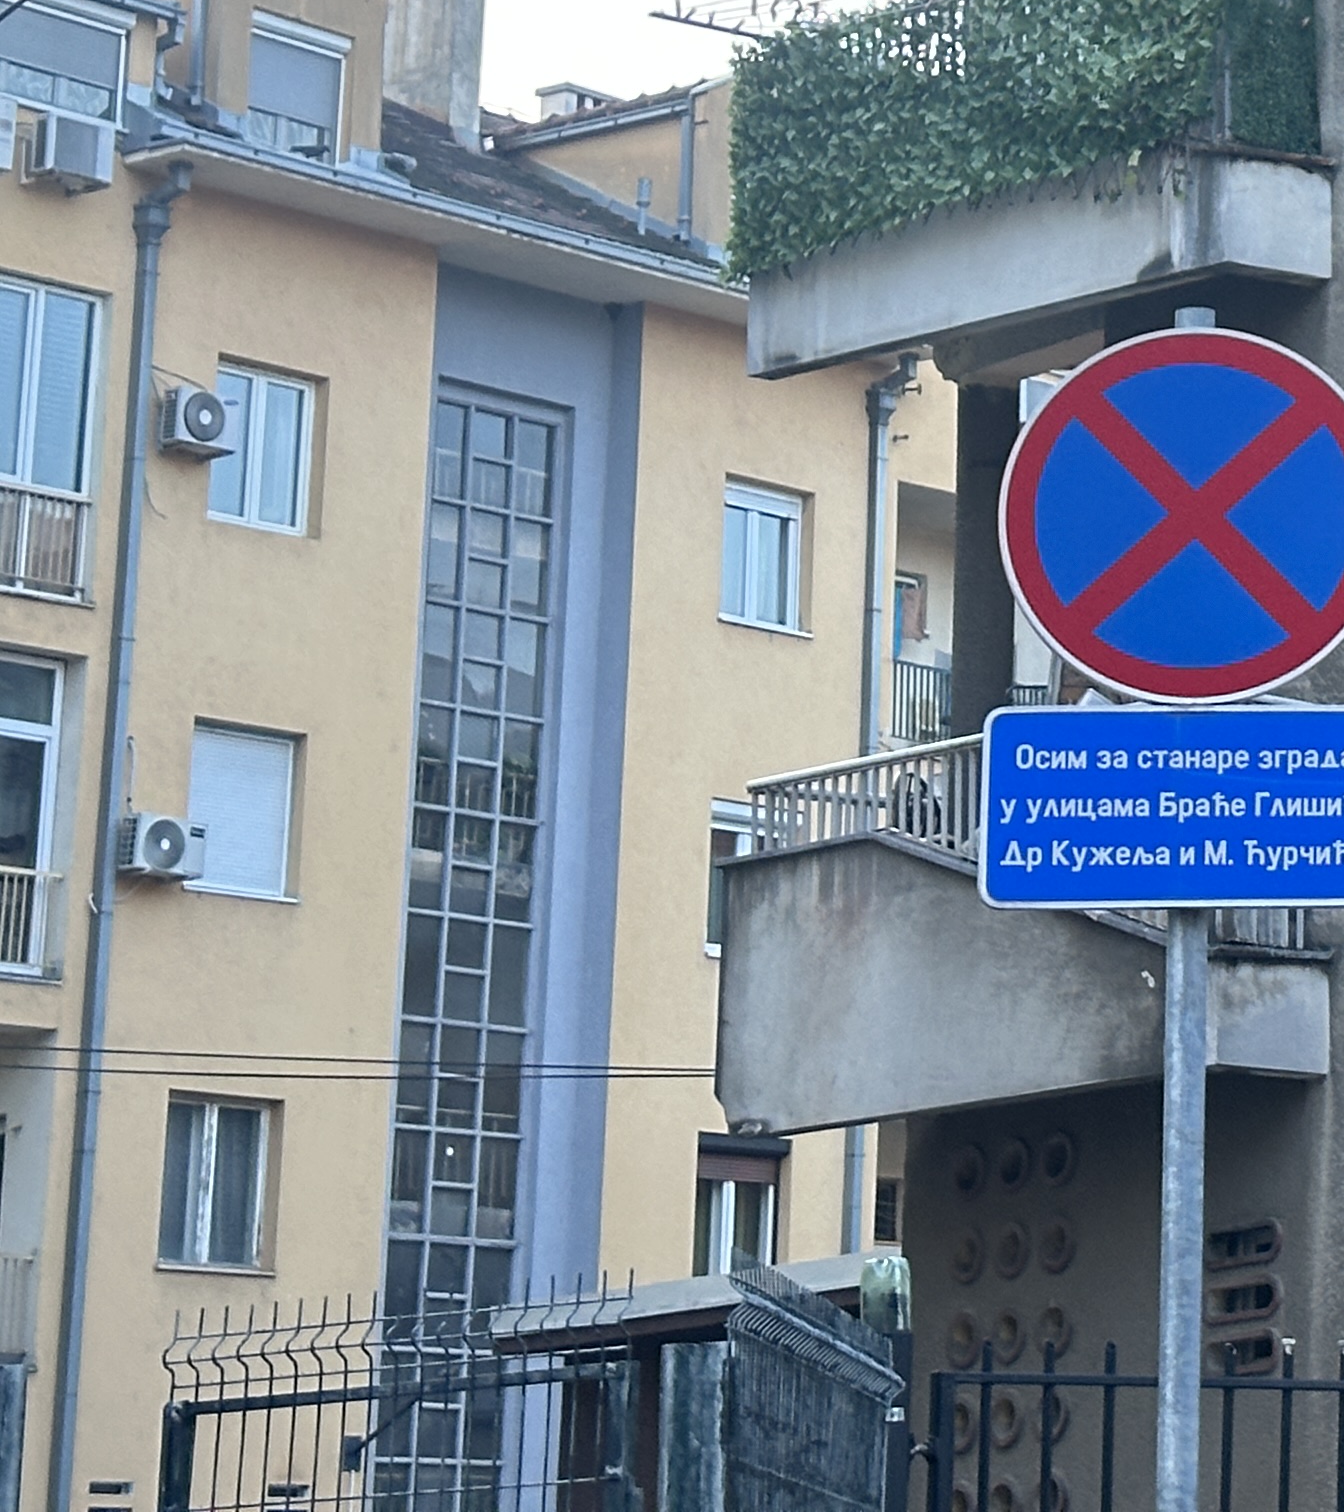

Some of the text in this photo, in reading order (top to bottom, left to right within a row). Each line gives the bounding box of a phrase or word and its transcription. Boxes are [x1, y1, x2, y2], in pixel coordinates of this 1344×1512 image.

[1015, 743, 1087, 770] Осим
[1096, 750, 1129, 770] за
[1137, 749, 1250, 775] станаре
[1000, 798, 1017, 824] у
[1025, 798, 1150, 824] улицама
[1159, 791, 1247, 823] Браће
[999, 840, 1043, 873] Др
[1051, 839, 1171, 873] Кужеља
[1179, 846, 1195, 866] и
[1203, 839, 1234, 866] М.
